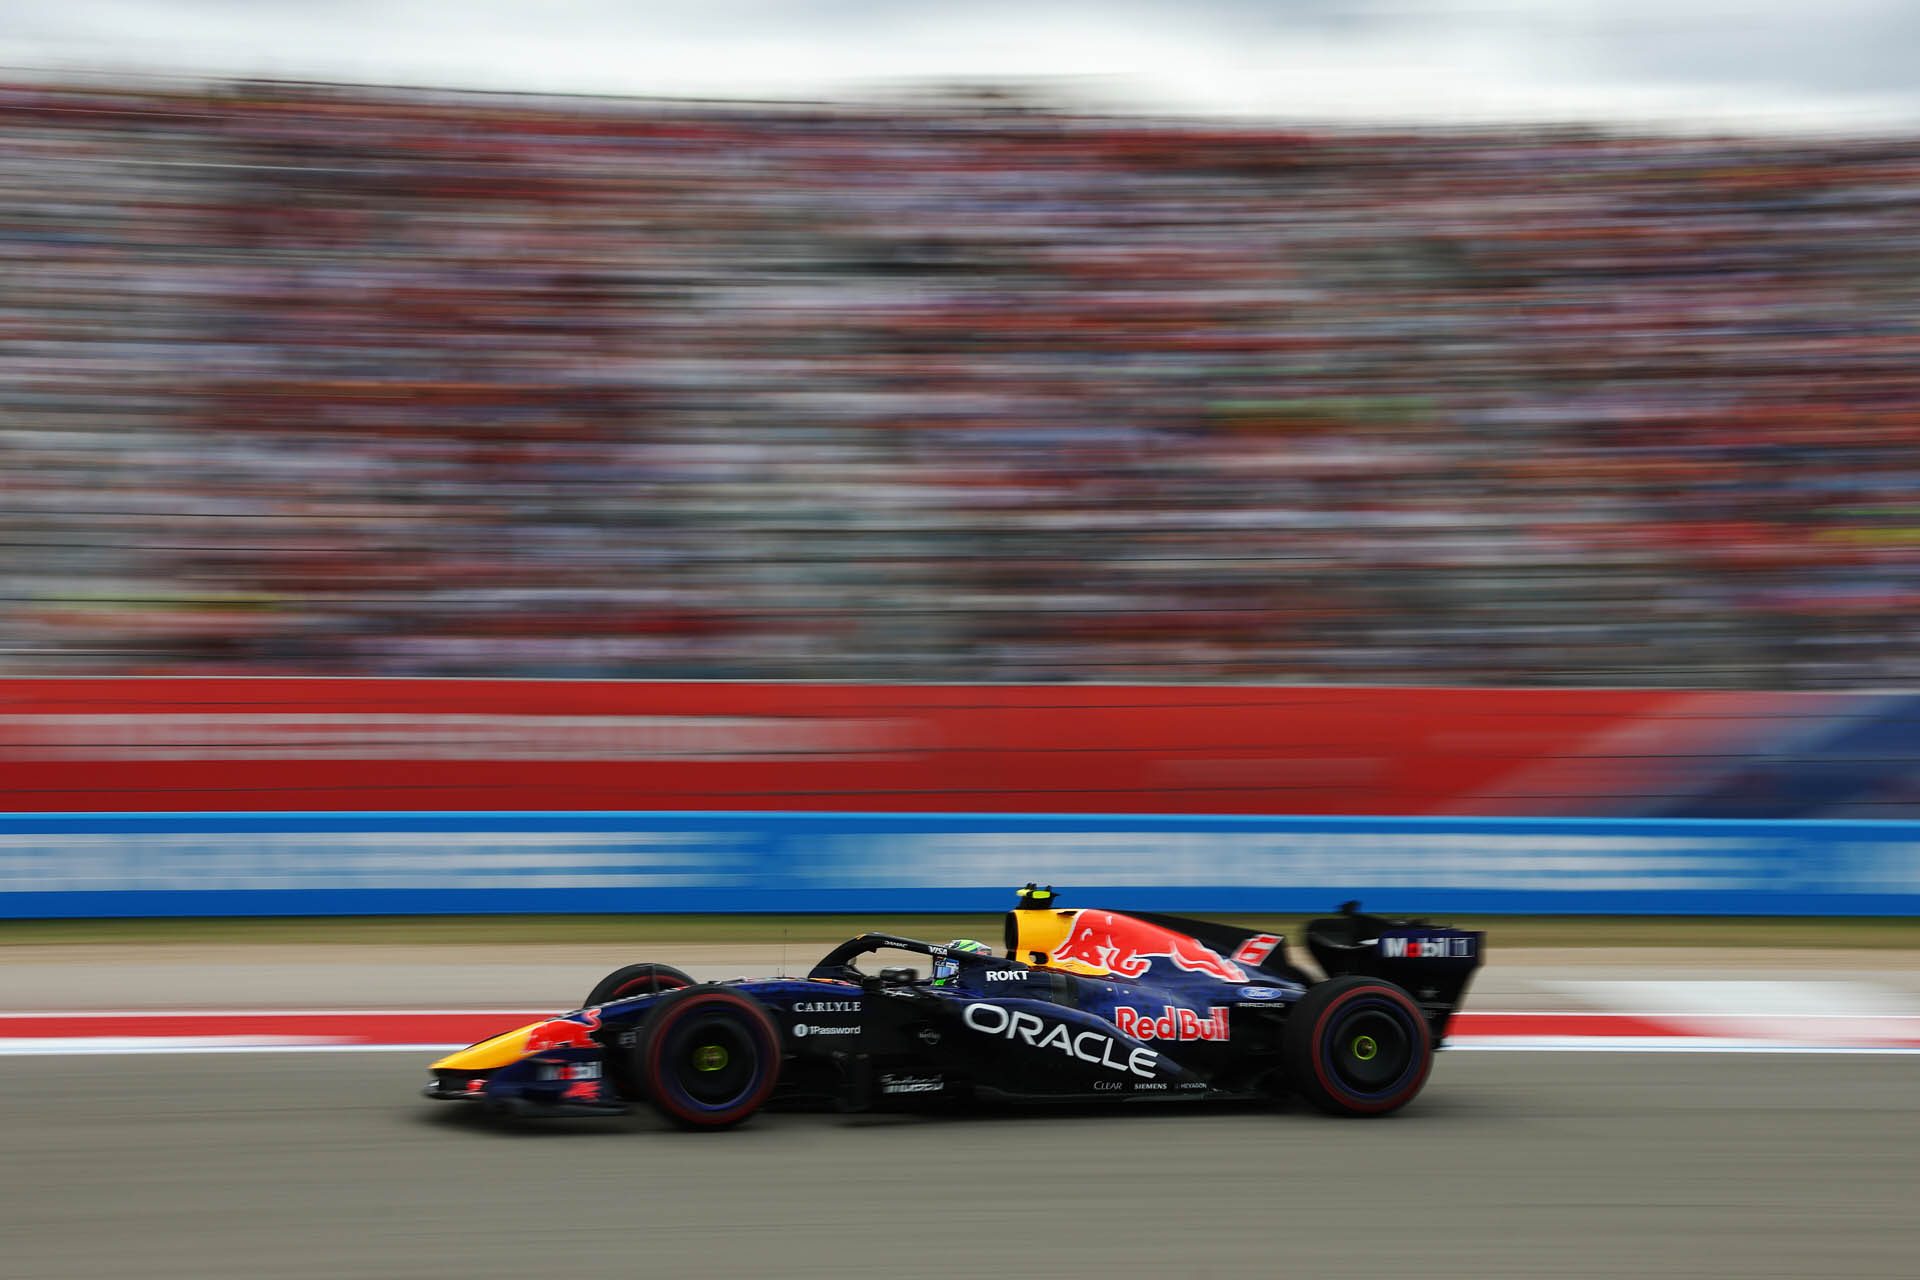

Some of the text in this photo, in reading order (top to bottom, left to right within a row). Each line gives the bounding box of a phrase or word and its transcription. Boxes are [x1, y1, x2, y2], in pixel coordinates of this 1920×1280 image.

[928, 945, 948, 956] VISA
[1383, 937, 1449, 957] Mobil
[986, 970, 1029, 981] ROKT
[793, 1001, 861, 1013] CARLYLE
[1115, 1006, 1230, 1041] Red Bull
[809, 1025, 861, 1035] 1Password
[963, 1003, 1159, 1079] ORACLE
[1134, 1082, 1167, 1090] SIEMENS
